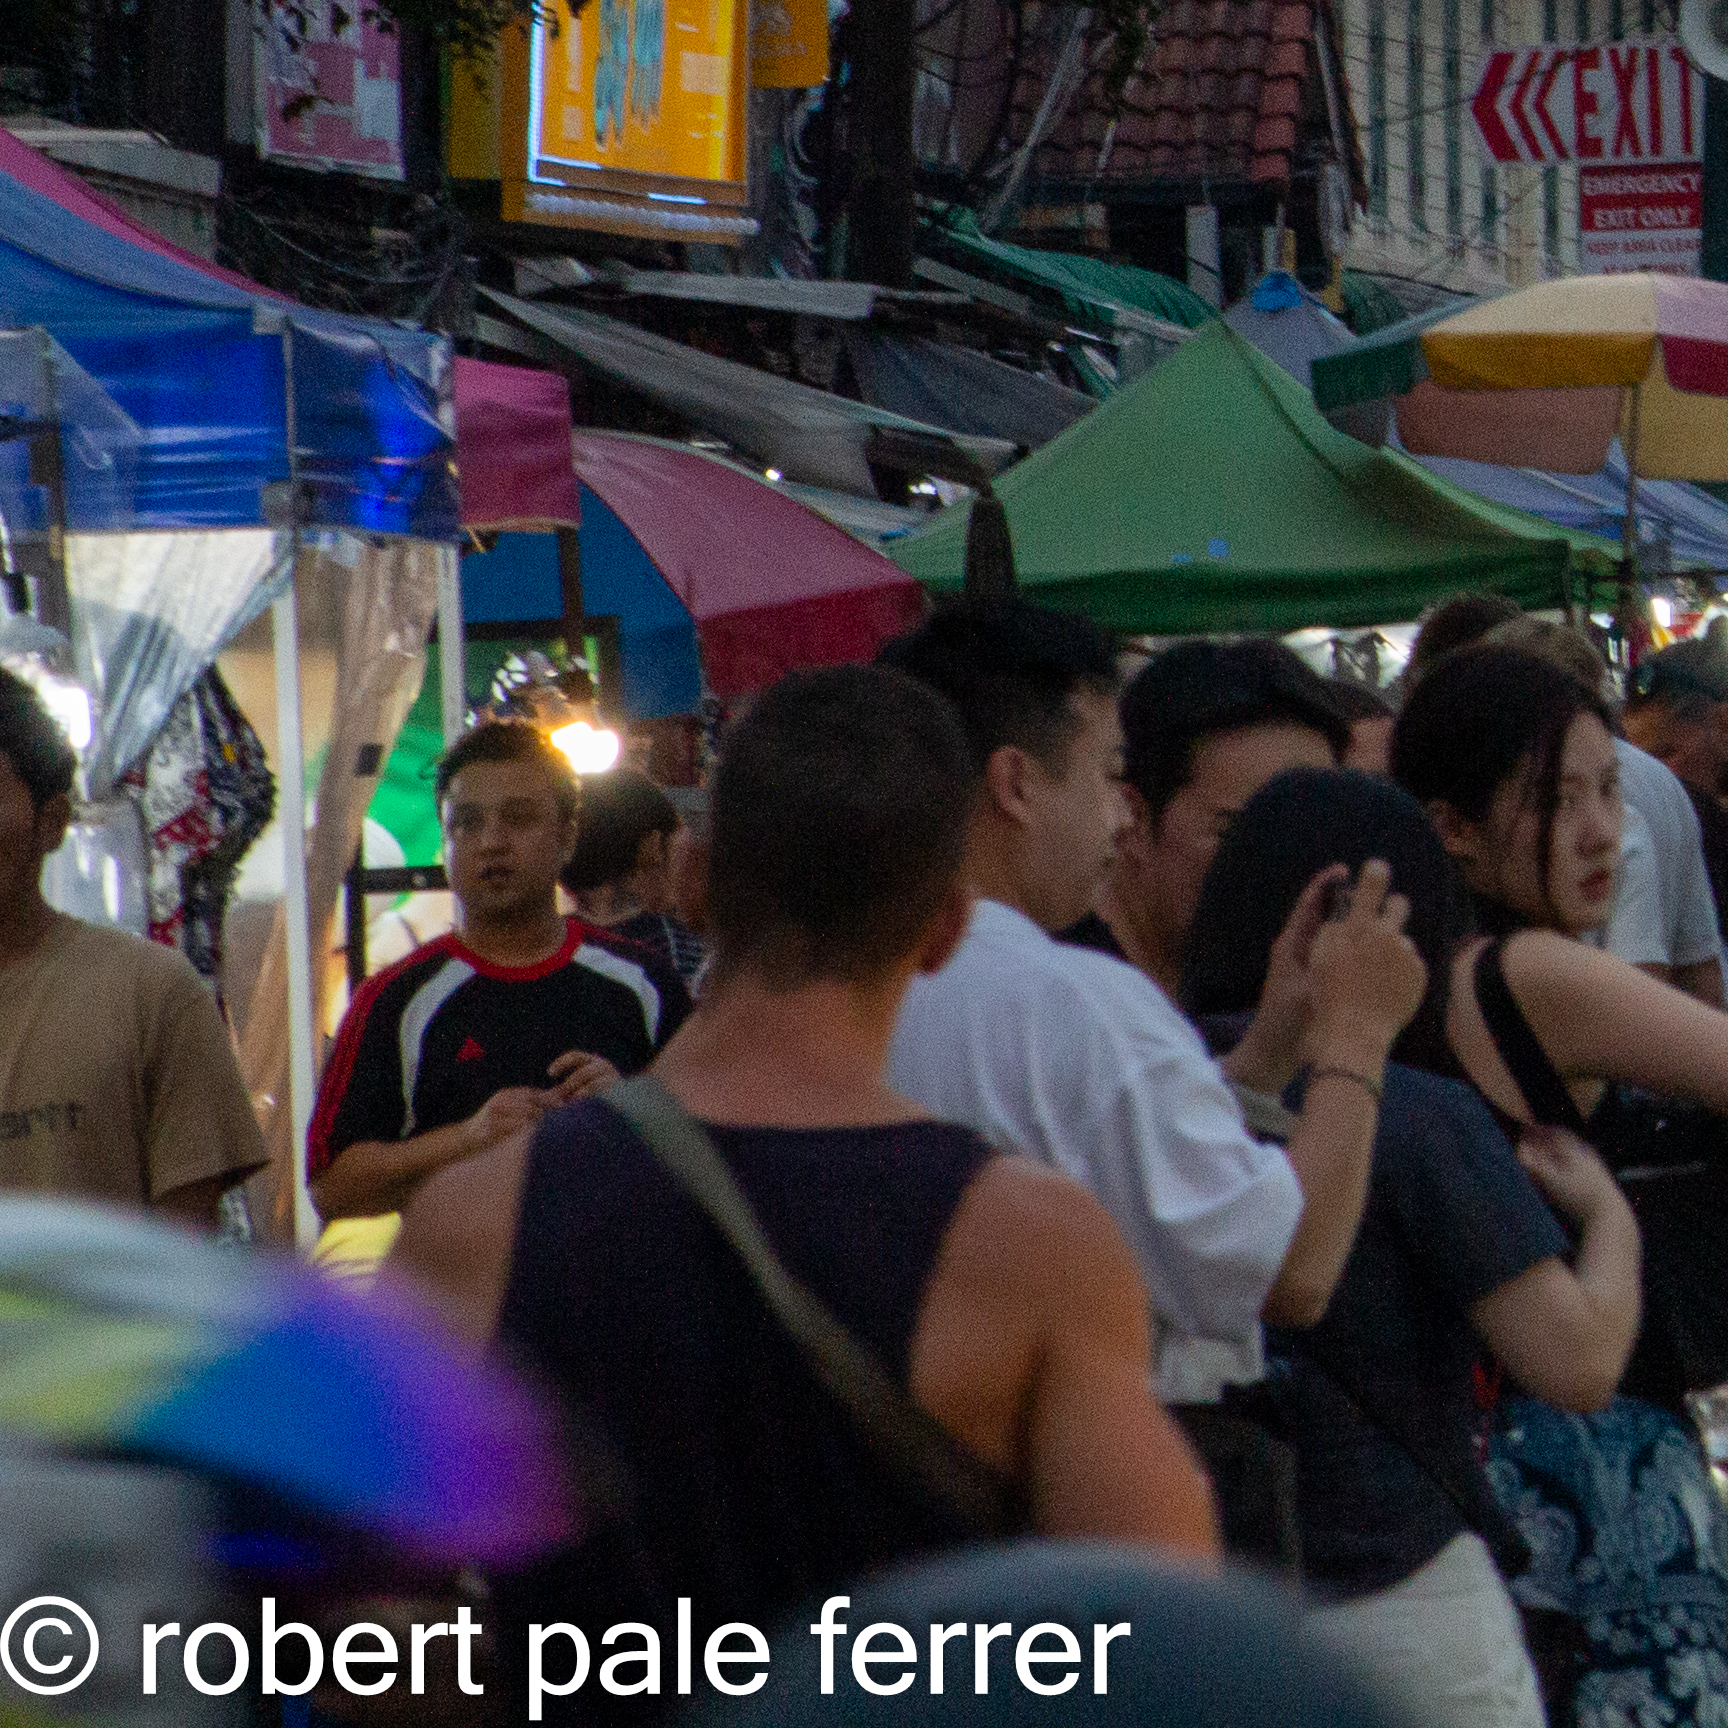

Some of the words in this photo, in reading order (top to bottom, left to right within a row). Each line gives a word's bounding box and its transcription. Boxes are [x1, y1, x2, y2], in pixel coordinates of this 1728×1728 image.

[1575, 48, 1693, 158] EXIT
[1583, 174, 1701, 196] EMERGENCY
[1593, 209, 1636, 230] EXIT
[1640, 207, 1692, 228] ONLY
